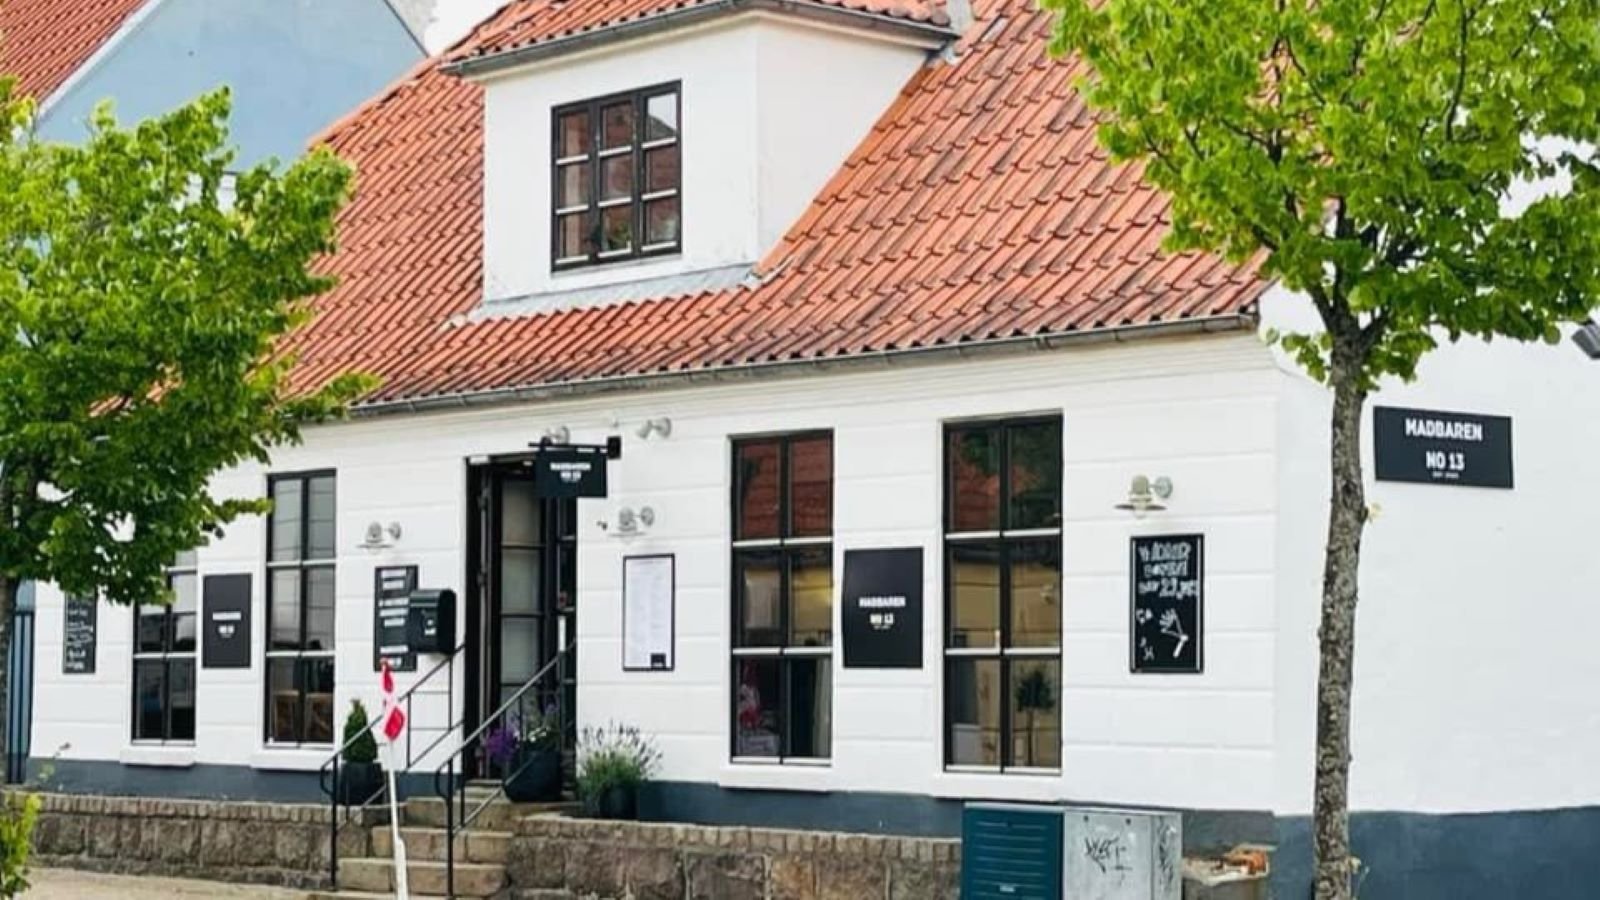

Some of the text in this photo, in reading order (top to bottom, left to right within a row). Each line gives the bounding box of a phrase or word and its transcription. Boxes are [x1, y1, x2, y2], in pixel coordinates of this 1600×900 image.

[1405, 418, 1483, 441] MADBAREN
[1425, 451, 1465, 471] NO 13
